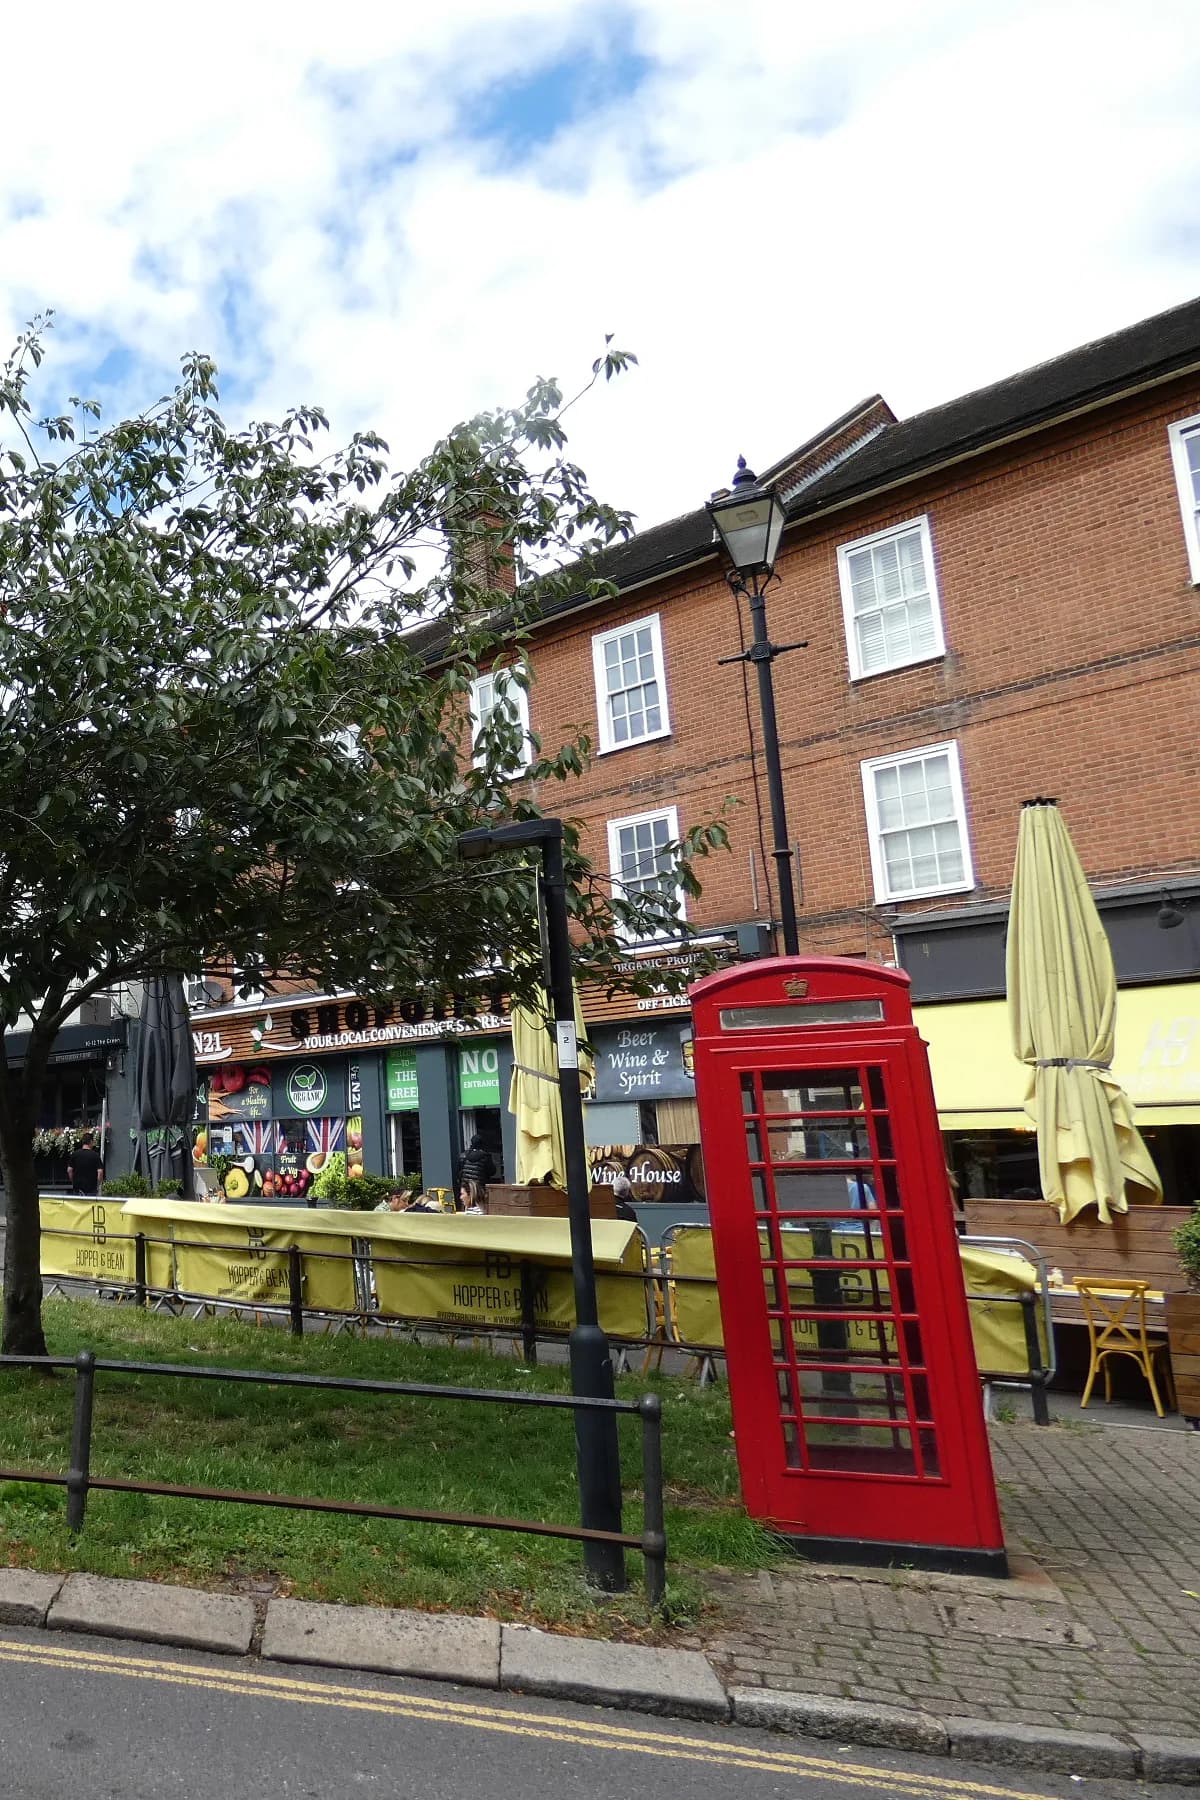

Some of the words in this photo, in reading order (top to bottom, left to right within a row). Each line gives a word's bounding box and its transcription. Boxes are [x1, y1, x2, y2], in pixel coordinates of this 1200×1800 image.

[614, 958, 662, 972] ORGANIC
[638, 1000, 658, 1010] OFF
[304, 1034, 334, 1049] YOUR
[335, 1030, 370, 1046] LOCAL
[371, 1020, 453, 1041] CONVENIENCE
[454, 1015, 499, 1032] SRE
[617, 1030, 657, 1047] Beer
[192, 1032, 222, 1054] N21
[461, 1048, 498, 1074] NO
[608, 1051, 648, 1068] Wine
[652, 1049, 669, 1065] &
[395, 1070, 417, 1082] THE
[464, 1080, 499, 1088] ENTRANCE
[618, 1069, 662, 1094] Spirit
[281, 1155, 296, 1163] Fruit
[590, 1166, 625, 1183] Wine
[629, 1161, 681, 1183] House
[107, 1251, 125, 1271] BEAN
[228, 1264, 259, 1286] HOPPER
[453, 1284, 500, 1309] HOPPER
[513, 1288, 549, 1313] BAN
